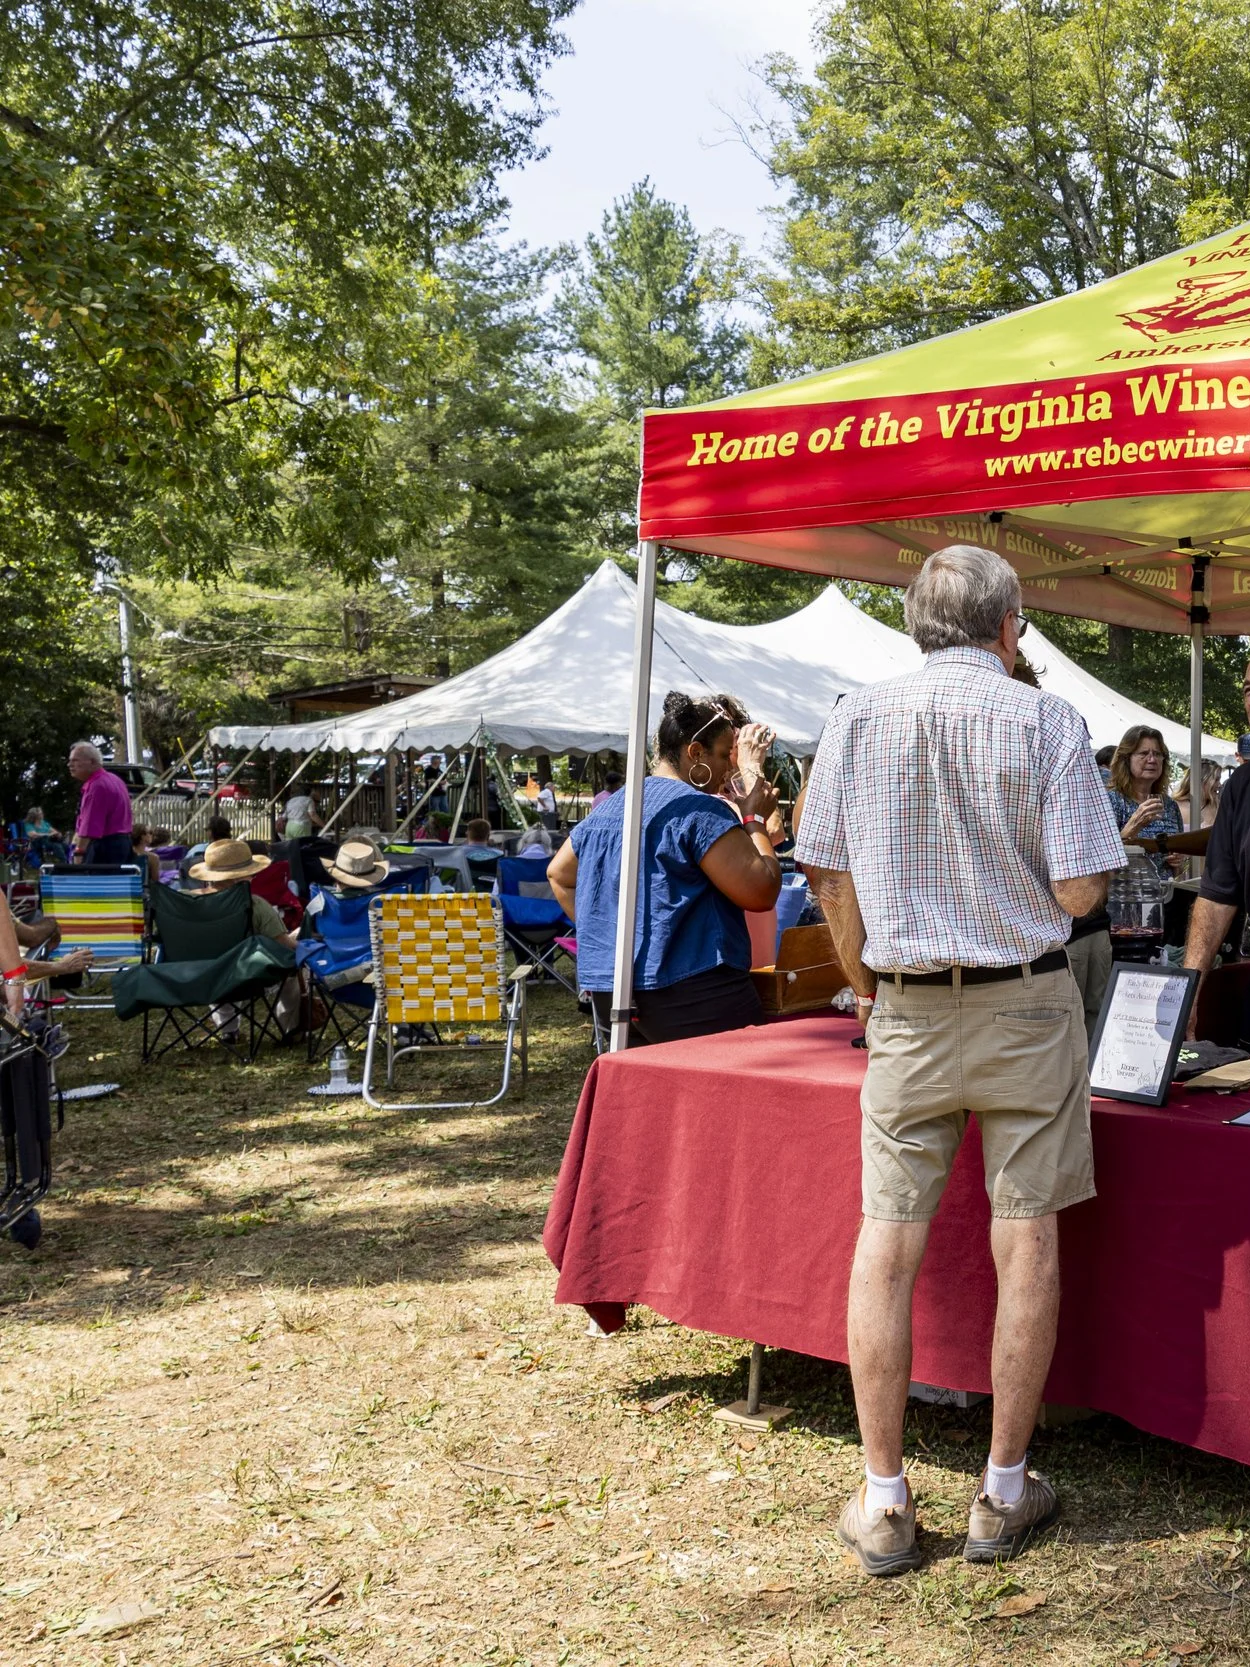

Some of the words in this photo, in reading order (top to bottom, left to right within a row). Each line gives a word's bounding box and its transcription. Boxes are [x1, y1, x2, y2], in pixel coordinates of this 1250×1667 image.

[686, 431, 799, 467] Home
[808, 415, 856, 454] of
[860, 411, 922, 448] the
[936, 382, 1113, 443] Virginia
